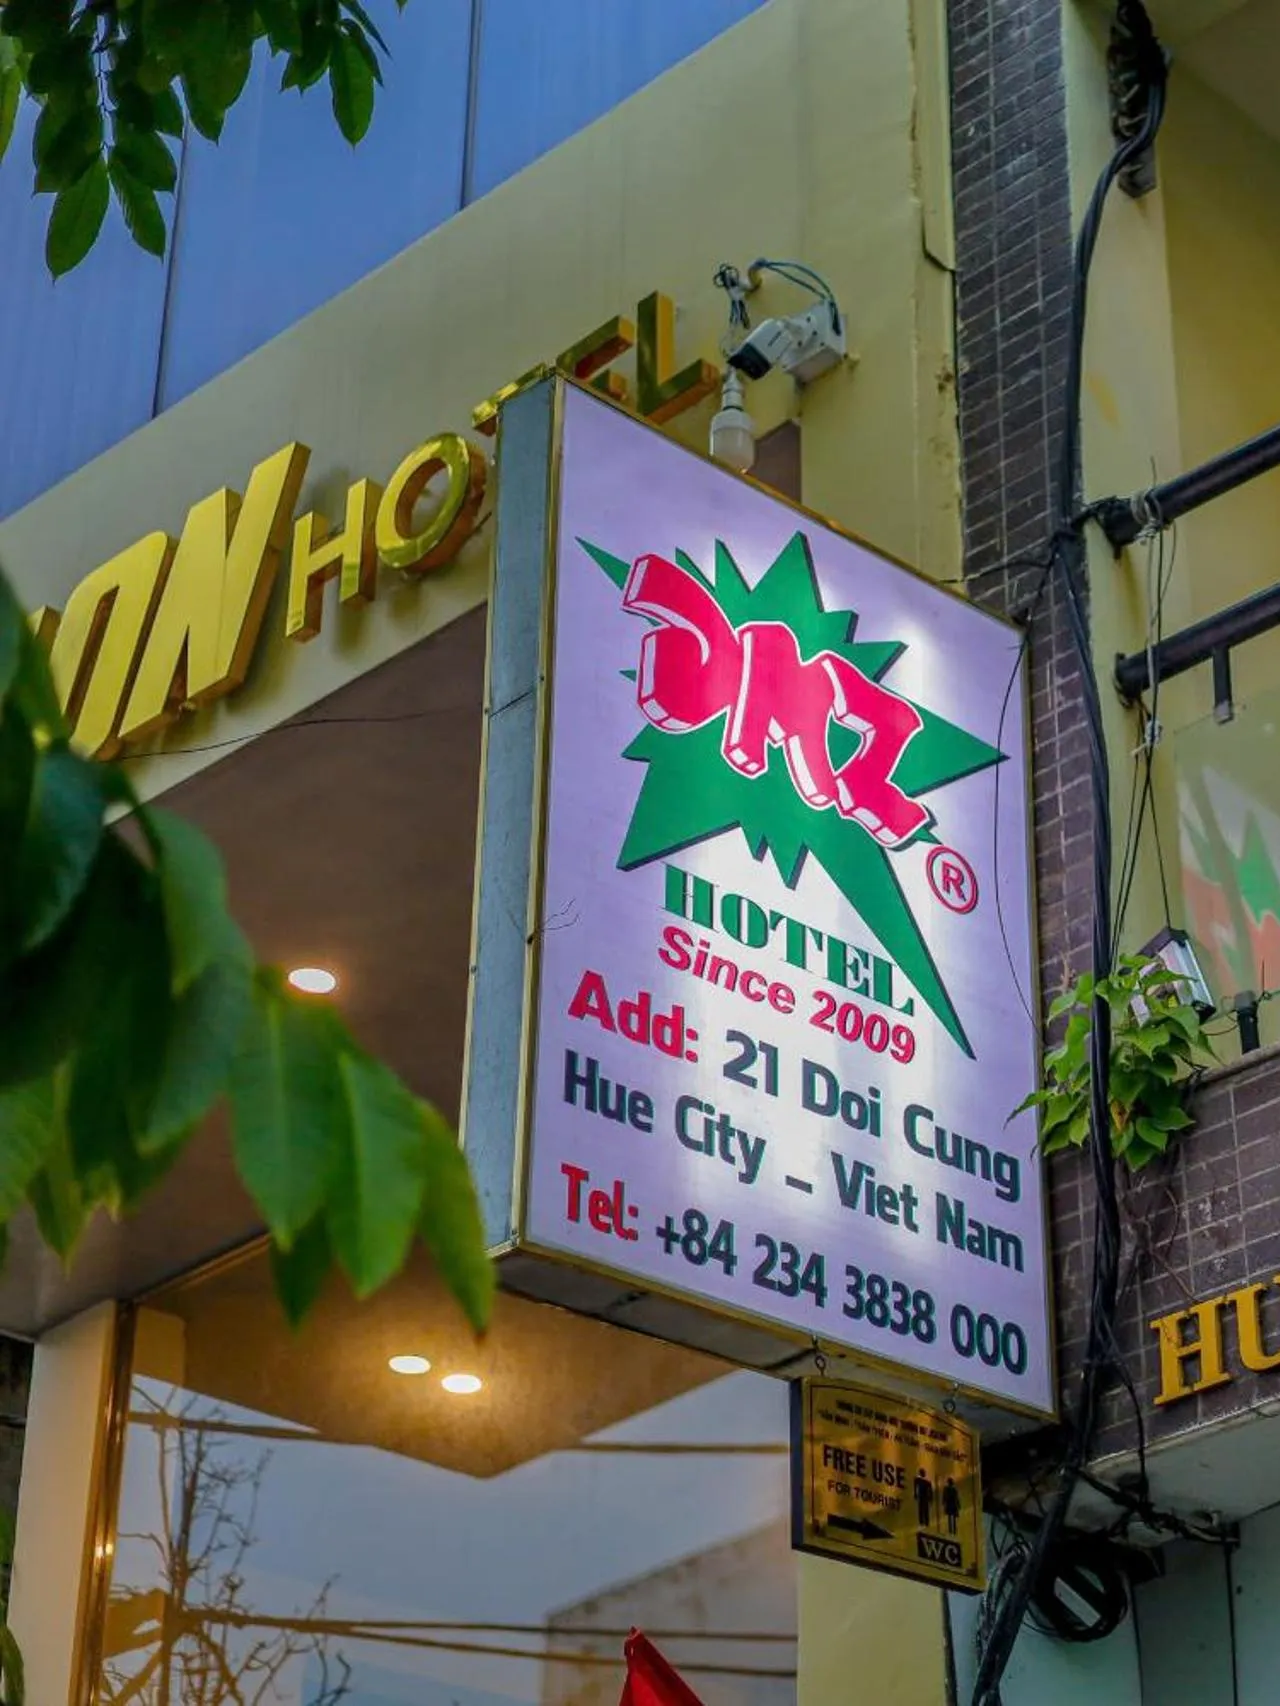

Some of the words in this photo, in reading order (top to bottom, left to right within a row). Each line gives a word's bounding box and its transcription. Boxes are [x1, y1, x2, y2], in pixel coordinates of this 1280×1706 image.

[658, 926, 796, 1014] Since
[809, 990, 916, 1065] 2009
[660, 862, 916, 1017] HOTEL
[567, 970, 699, 1063] Add:
[723, 1029, 779, 1097] 21
[801, 1058, 883, 1137] Doi
[903, 1104, 1021, 1203] Cung
[563, 1049, 655, 1134] Hue
[674, 1095, 767, 1185] City
[831, 1151, 919, 1234] Viet
[935, 1191, 1025, 1273] Nam
[560, 1163, 639, 1242] Tel:
[656, 1208, 738, 1277] +84
[752, 1233, 828, 1308] 234
[842, 1265, 937, 1345] 3838
[950, 1304, 1028, 1376] 000
[823, 1444, 867, 1477] FREE
[872, 1456, 905, 1489] USE
[827, 1480, 851, 1497] FOR
[921, 1536, 960, 1565] WC
